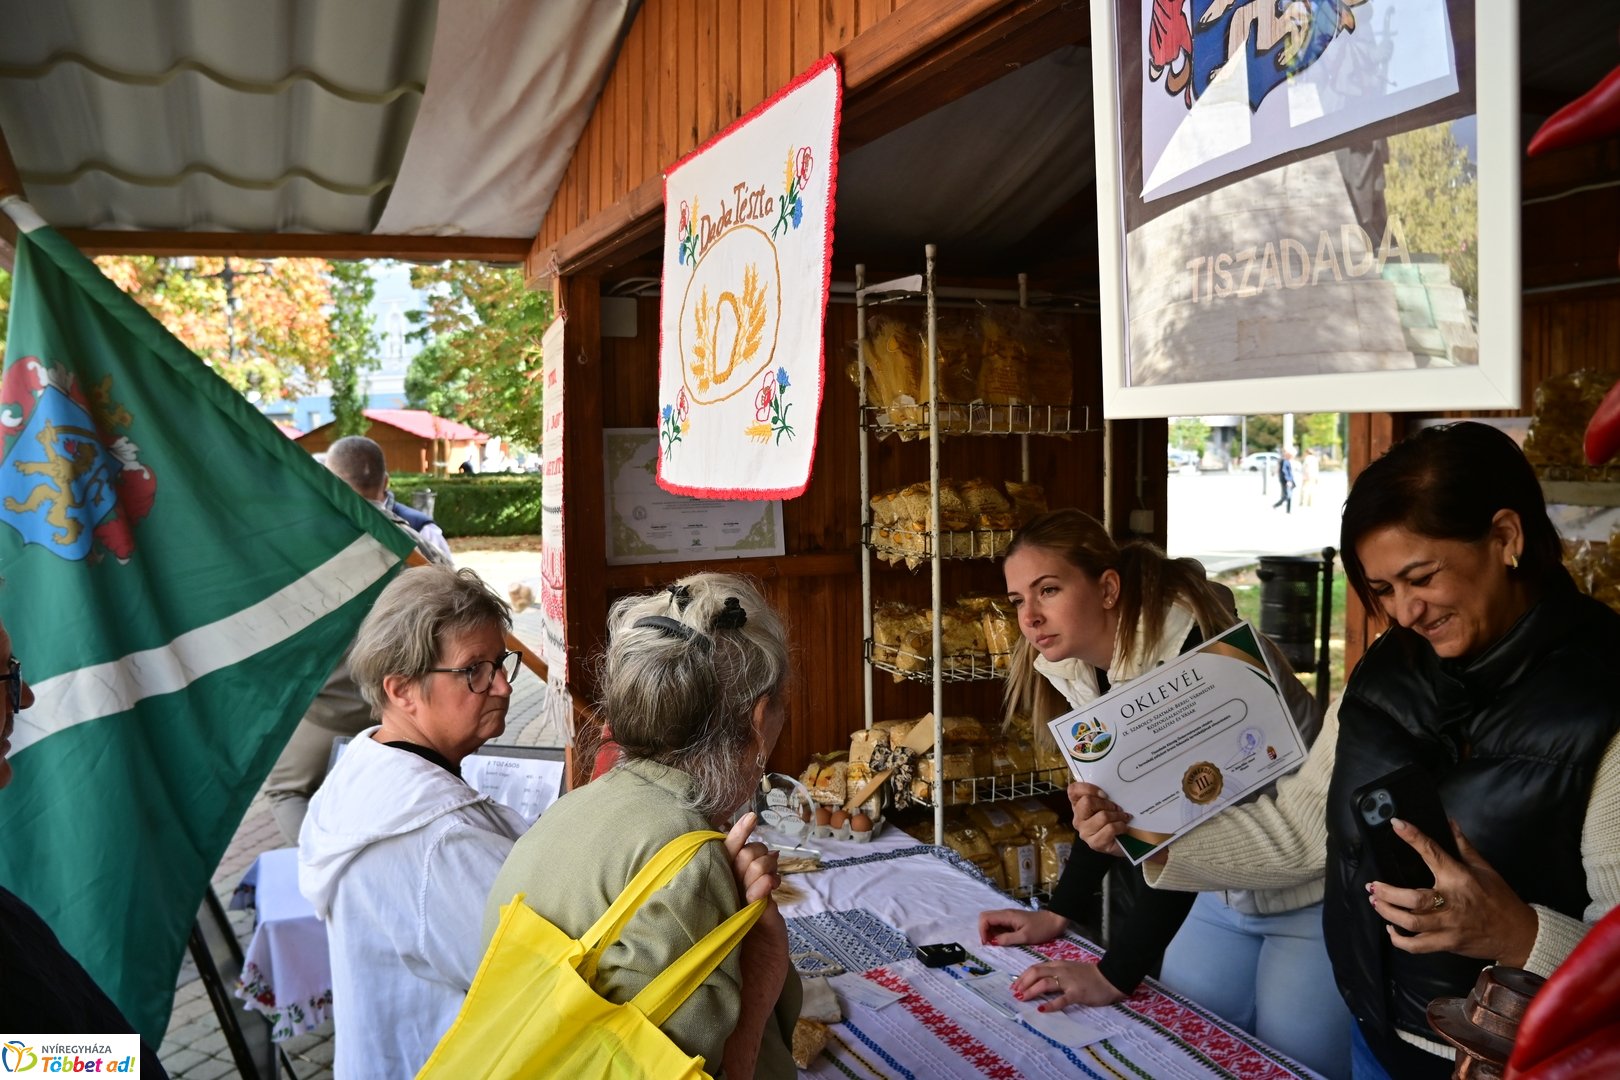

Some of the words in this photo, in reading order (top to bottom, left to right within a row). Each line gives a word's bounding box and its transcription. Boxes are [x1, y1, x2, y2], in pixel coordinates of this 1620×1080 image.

[699, 200, 732, 257] Dada
[733, 182, 774, 225] Tészta
[1186, 214, 1412, 304] TISZADADA
[1120, 668, 1204, 719] OKLEVÉL
[1195, 775, 1213, 791] III.
